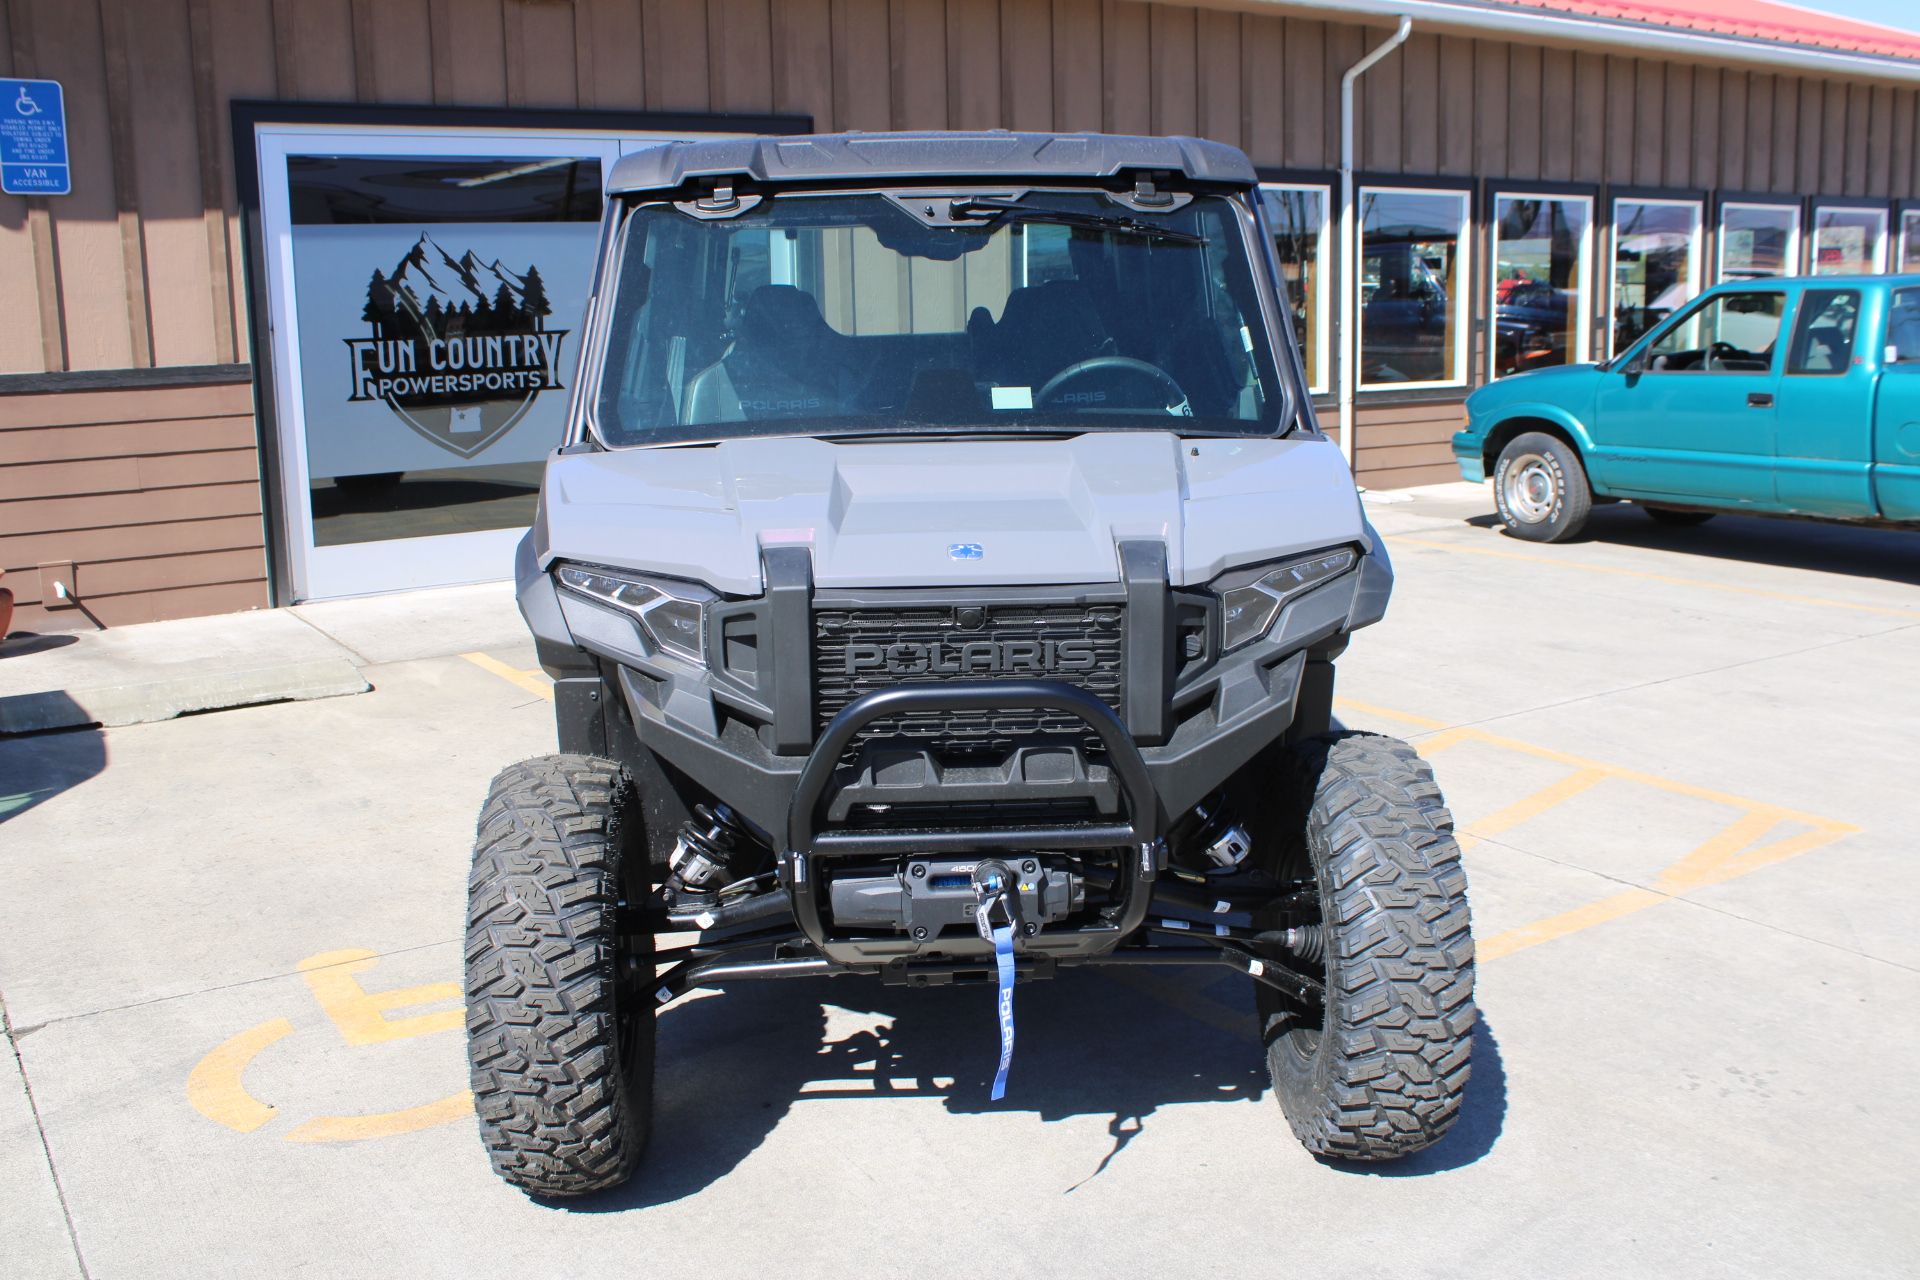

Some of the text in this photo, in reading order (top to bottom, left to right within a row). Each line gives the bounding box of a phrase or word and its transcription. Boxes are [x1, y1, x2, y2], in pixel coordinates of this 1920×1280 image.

[24, 168, 48, 178] VAN
[13, 179, 60, 187] ACCESSIBLE
[350, 332, 562, 399] FUN COUNTRY
[379, 370, 542, 396] POWERSPORTS
[741, 398, 820, 411] POLARIS
[844, 639, 1096, 675] POLARIS
[951, 864, 978, 873] 450
[1001, 986, 1013, 1071] POLARIS
